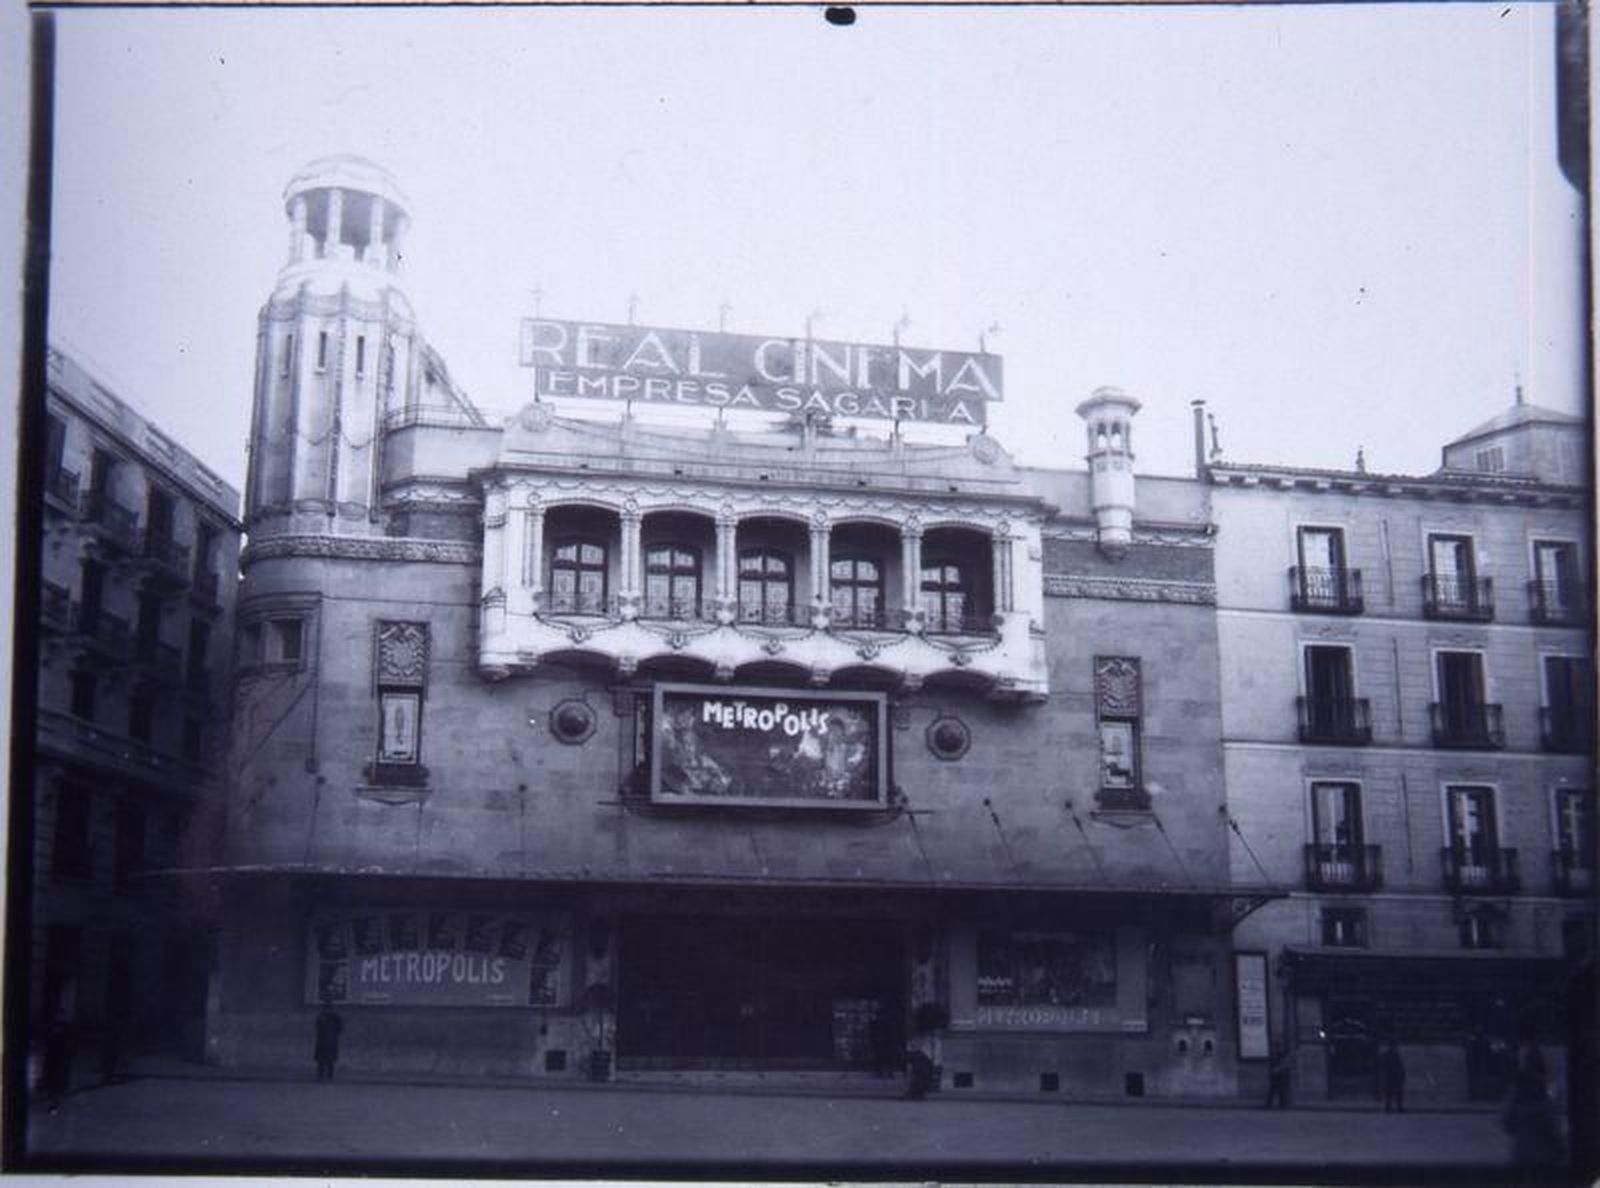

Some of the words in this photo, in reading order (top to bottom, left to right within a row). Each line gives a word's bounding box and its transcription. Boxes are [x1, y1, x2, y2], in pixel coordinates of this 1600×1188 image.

[522, 321, 727, 378] REAL
[755, 339, 1000, 398] CINEMA
[548, 371, 760, 408] EMPRESA
[702, 701, 831, 736] METROPOLIS
[361, 952, 505, 984] METROPOLIS
